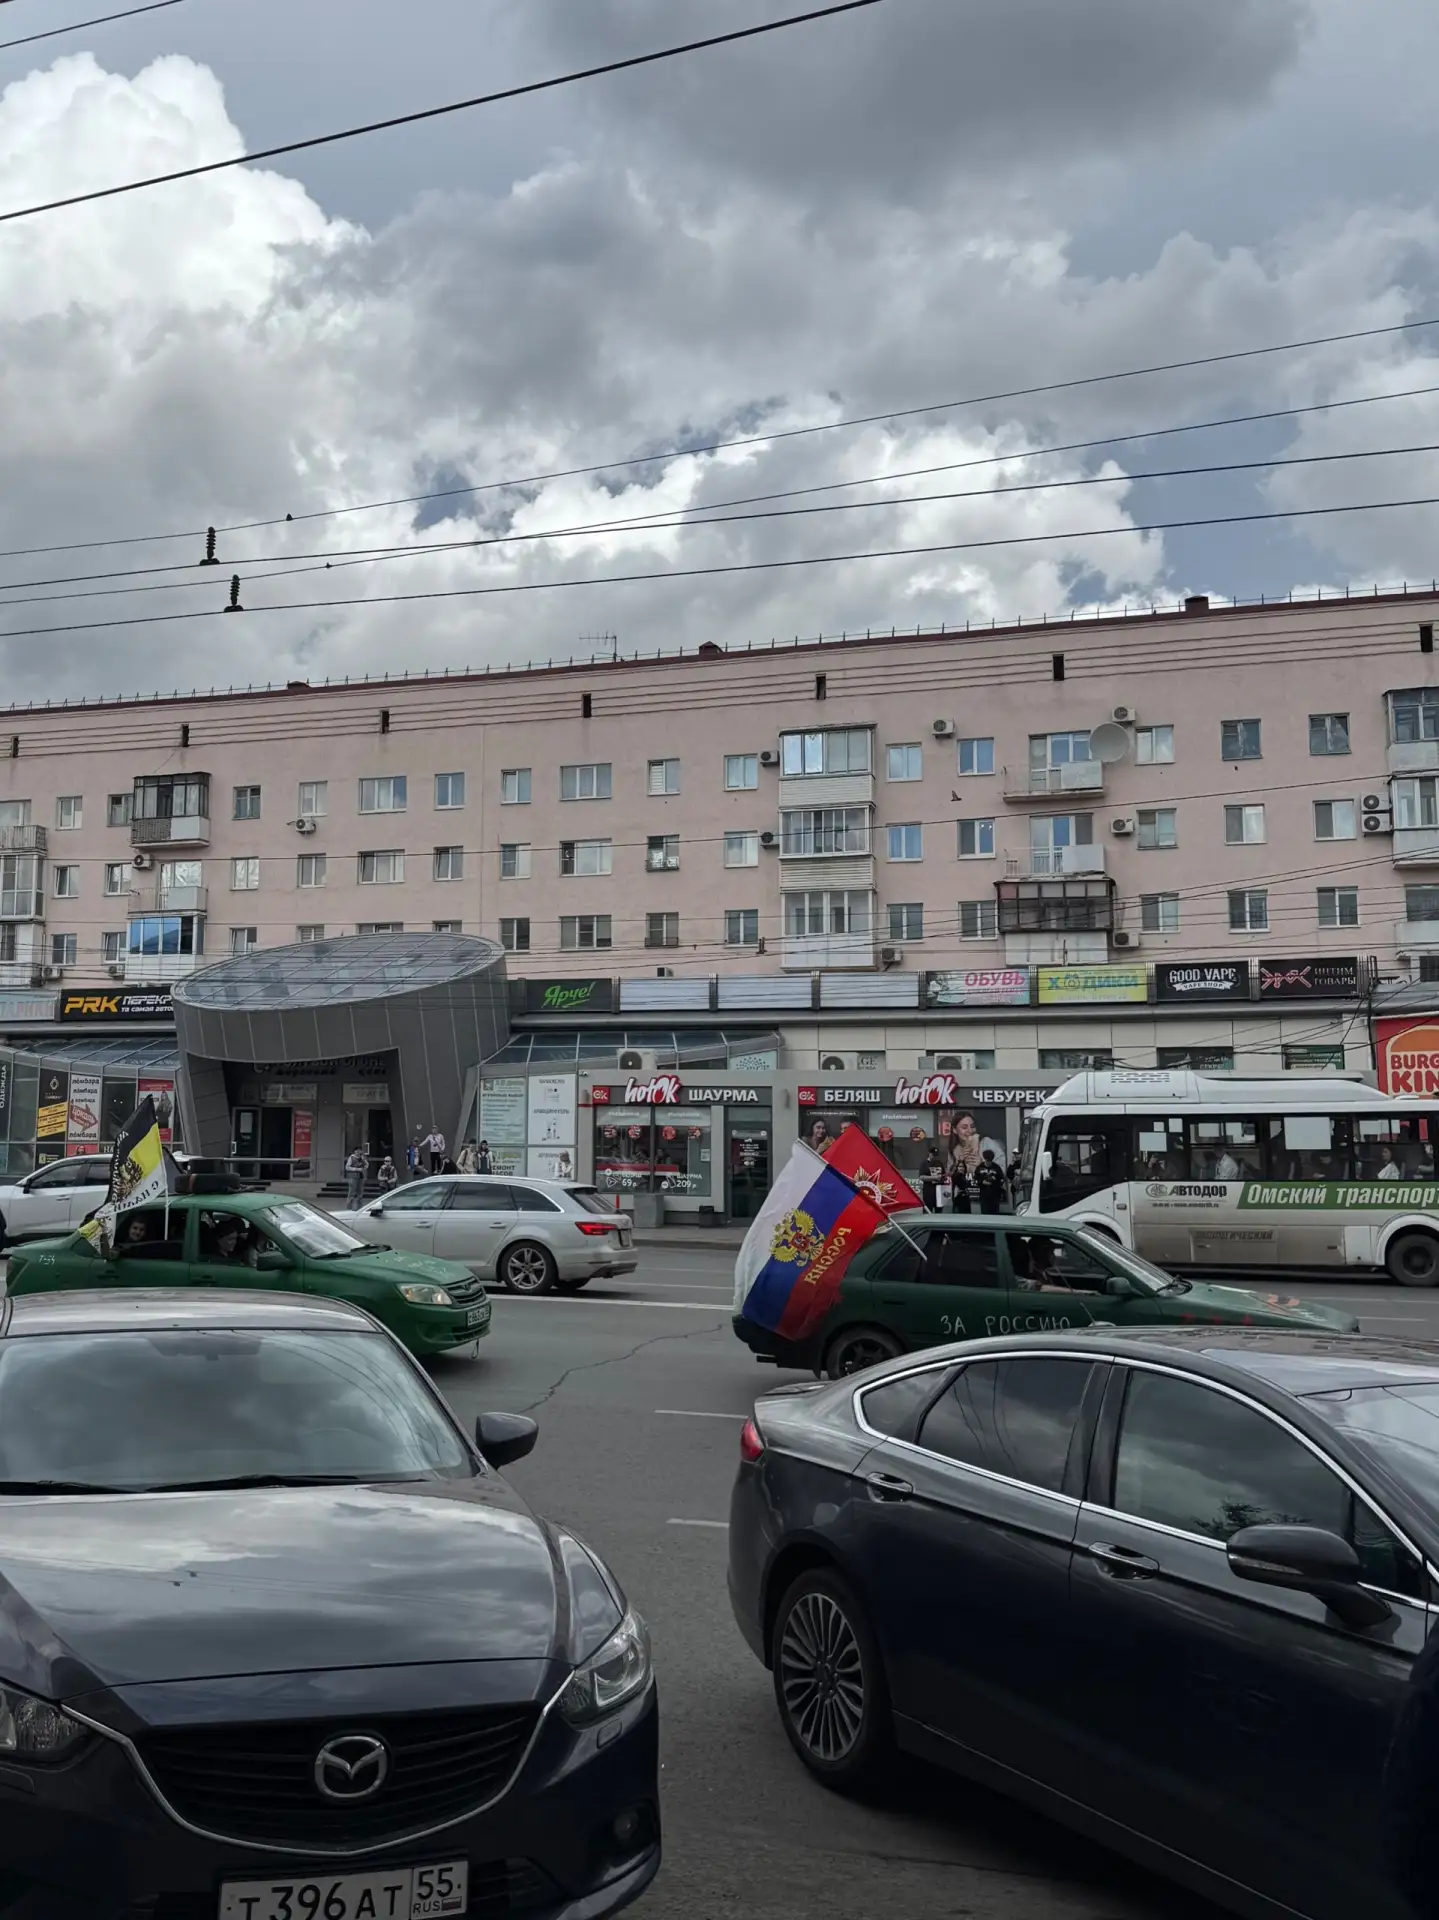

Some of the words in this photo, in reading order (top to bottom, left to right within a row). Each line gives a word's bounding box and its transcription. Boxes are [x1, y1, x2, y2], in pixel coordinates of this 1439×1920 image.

[1169, 969, 1200, 983] GOOD
[1204, 968, 1237, 982] VAPE
[1314, 967, 1354, 976] ИНТИМ
[965, 972, 1026, 986] ОБУВЬ
[1314, 977, 1357, 986] ТОВАРЫ
[64, 995, 122, 1014] PRK
[122, 995, 173, 1005] ПЕРЕКР
[688, 1088, 758, 1103] ШАУРМА
[824, 1089, 880, 1102] БЕЛЯШ
[972, 1090, 1046, 1102] ЧЕБУРЕК
[677, 1180, 692, 1188] 209
[1246, 1184, 1327, 1204] Омский
[940, 1315, 967, 1335] ЗА
[985, 1315, 1071, 1336] РОССИЮ
[417, 1867, 454, 1900] 55
[413, 1901, 441, 1914] RUS
